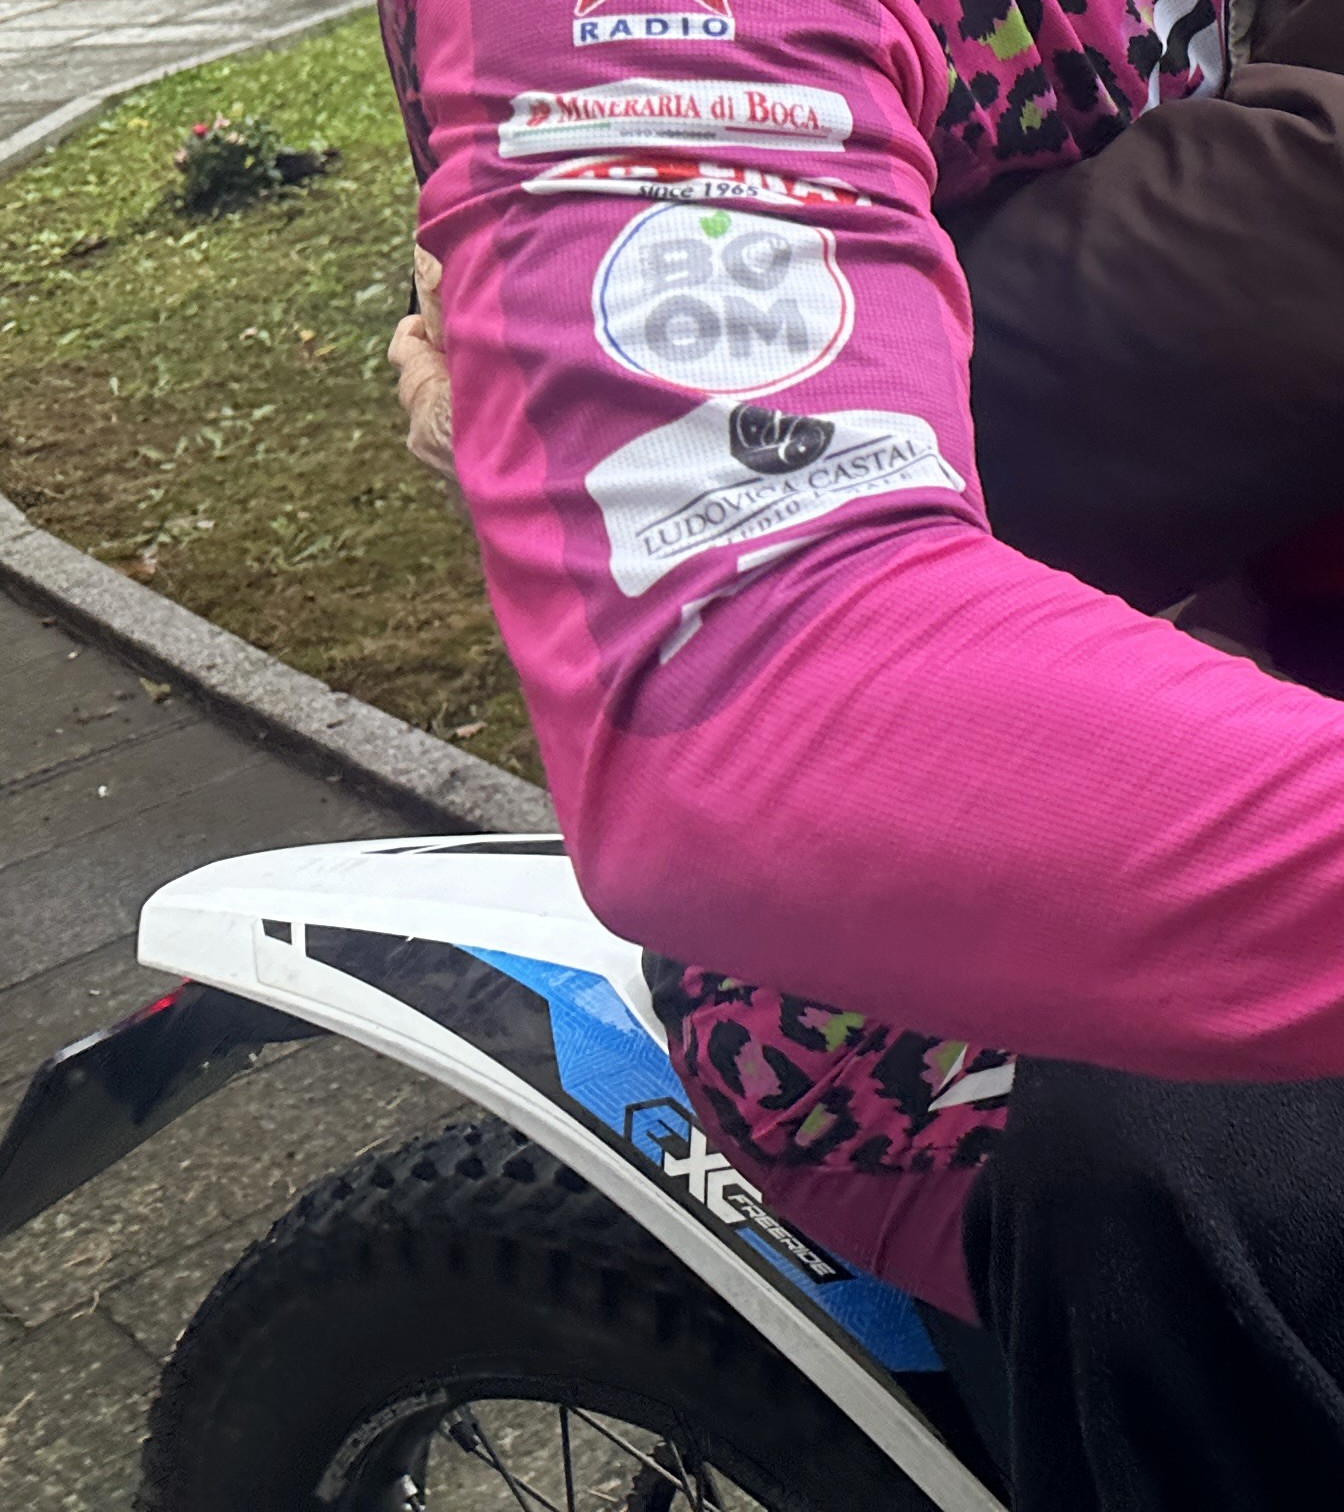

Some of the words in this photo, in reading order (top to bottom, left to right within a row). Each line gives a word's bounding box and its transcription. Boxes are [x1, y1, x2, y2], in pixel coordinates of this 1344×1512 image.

[579, 17, 729, 42] RADIO
[555, 93, 700, 123] MINERARIA
[710, 94, 735, 120] di
[746, 91, 820, 130] BOCA
[638, 181, 694, 200] since
[703, 181, 758, 198] 1965
[726, 1192, 838, 1278] FREERIDE
